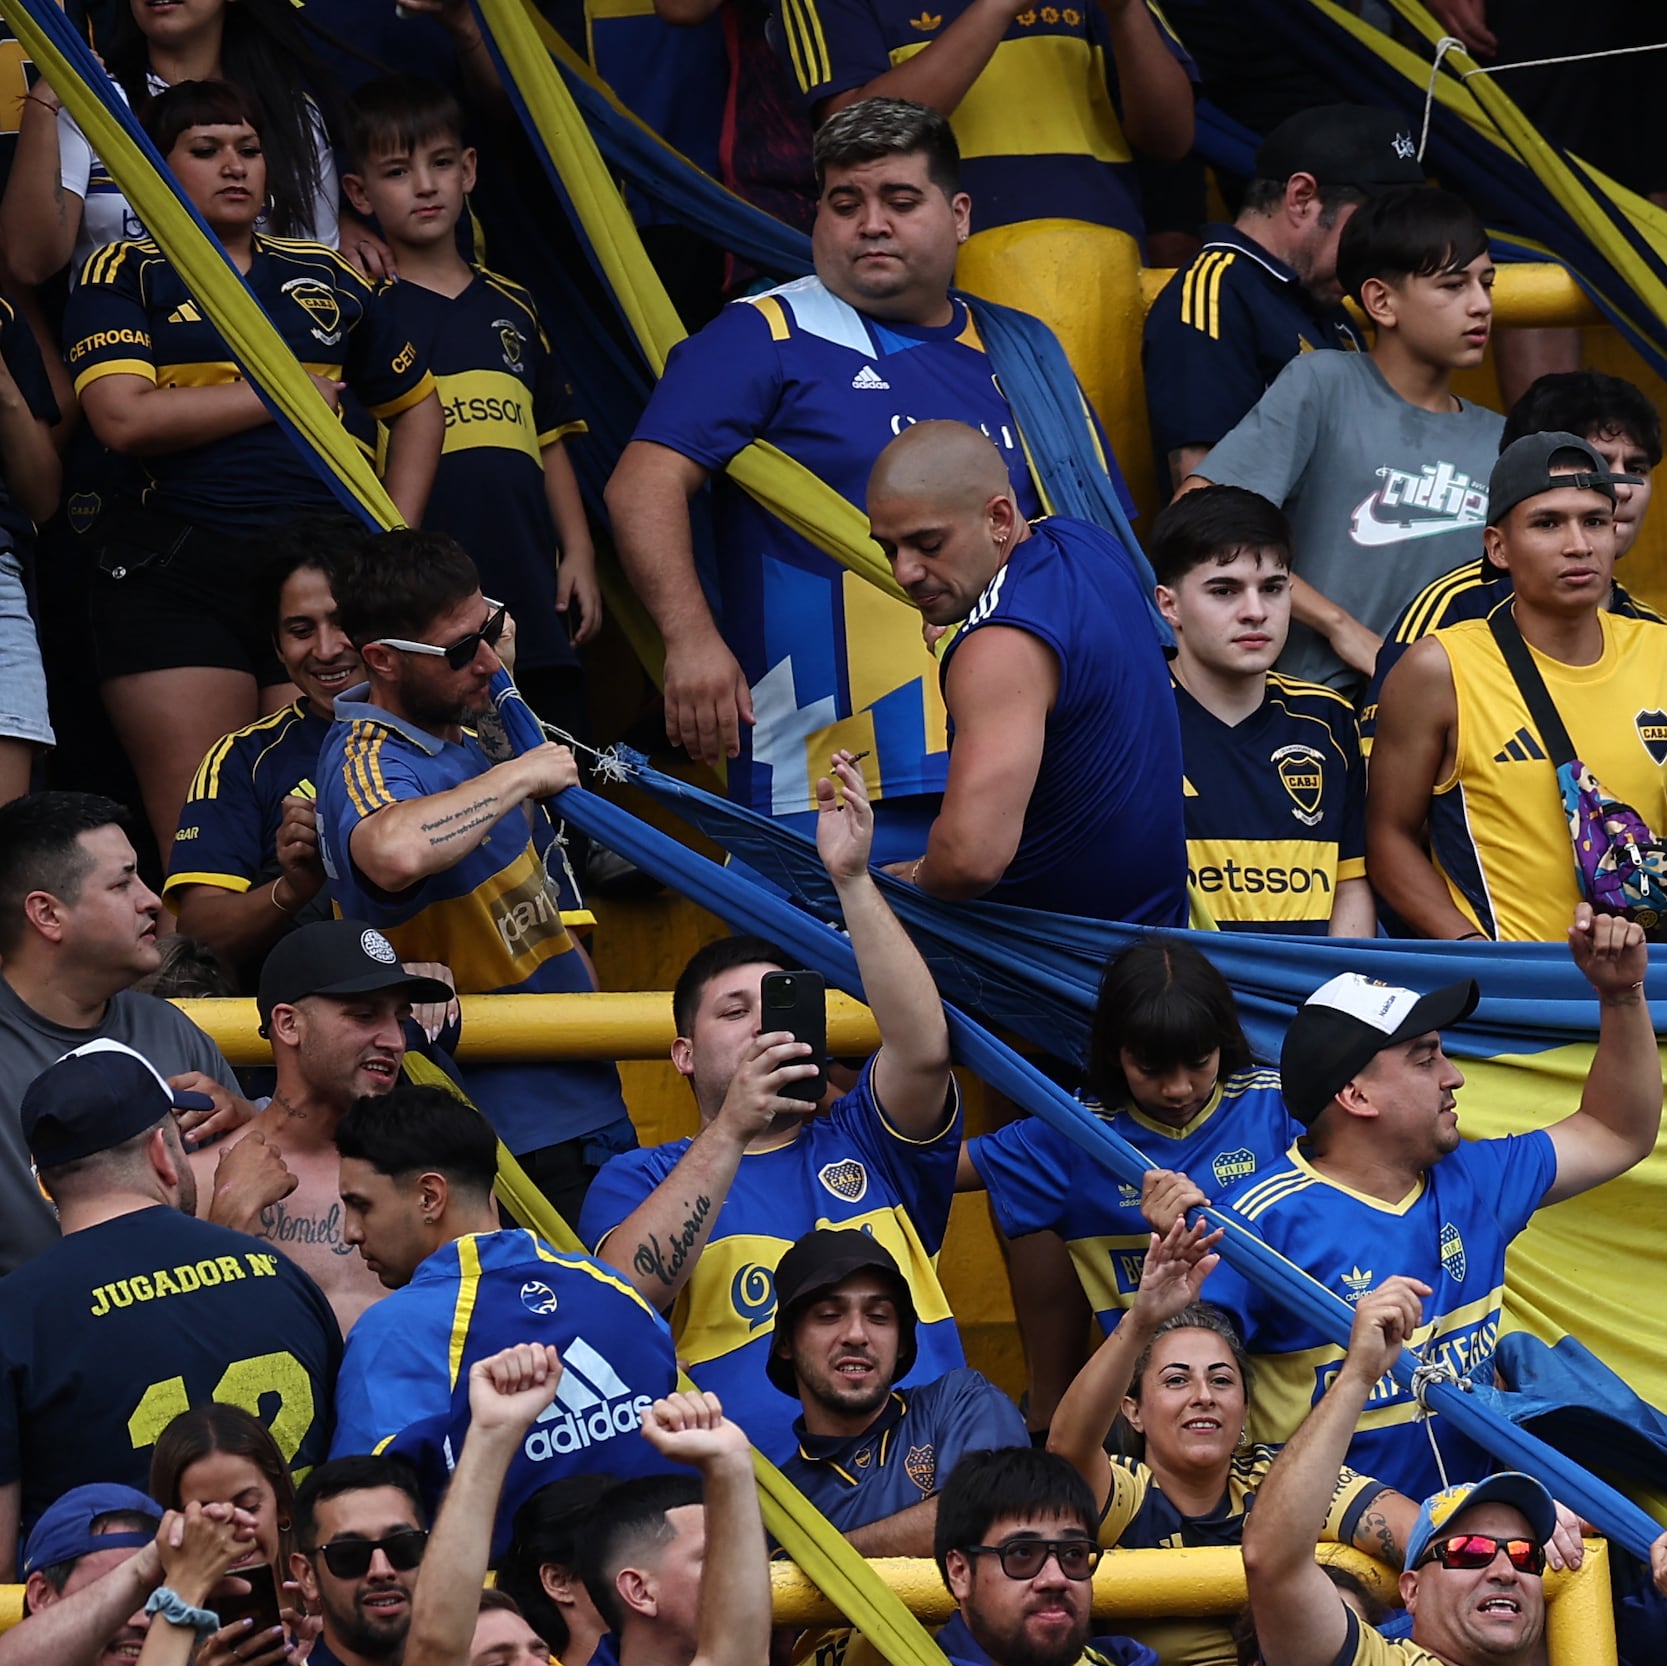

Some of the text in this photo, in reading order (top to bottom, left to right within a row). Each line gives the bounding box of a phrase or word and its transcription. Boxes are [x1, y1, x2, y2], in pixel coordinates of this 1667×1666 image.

[852, 379, 890, 390] adidas
[441, 393, 527, 428] etsson
[1288, 775, 1319, 788] CABJ
[1215, 1163, 1254, 1177] CABJ
[829, 1172, 862, 1190] CABJ
[90, 1261, 240, 1318] JUGADOR
[525, 1394, 654, 1462] adidas
